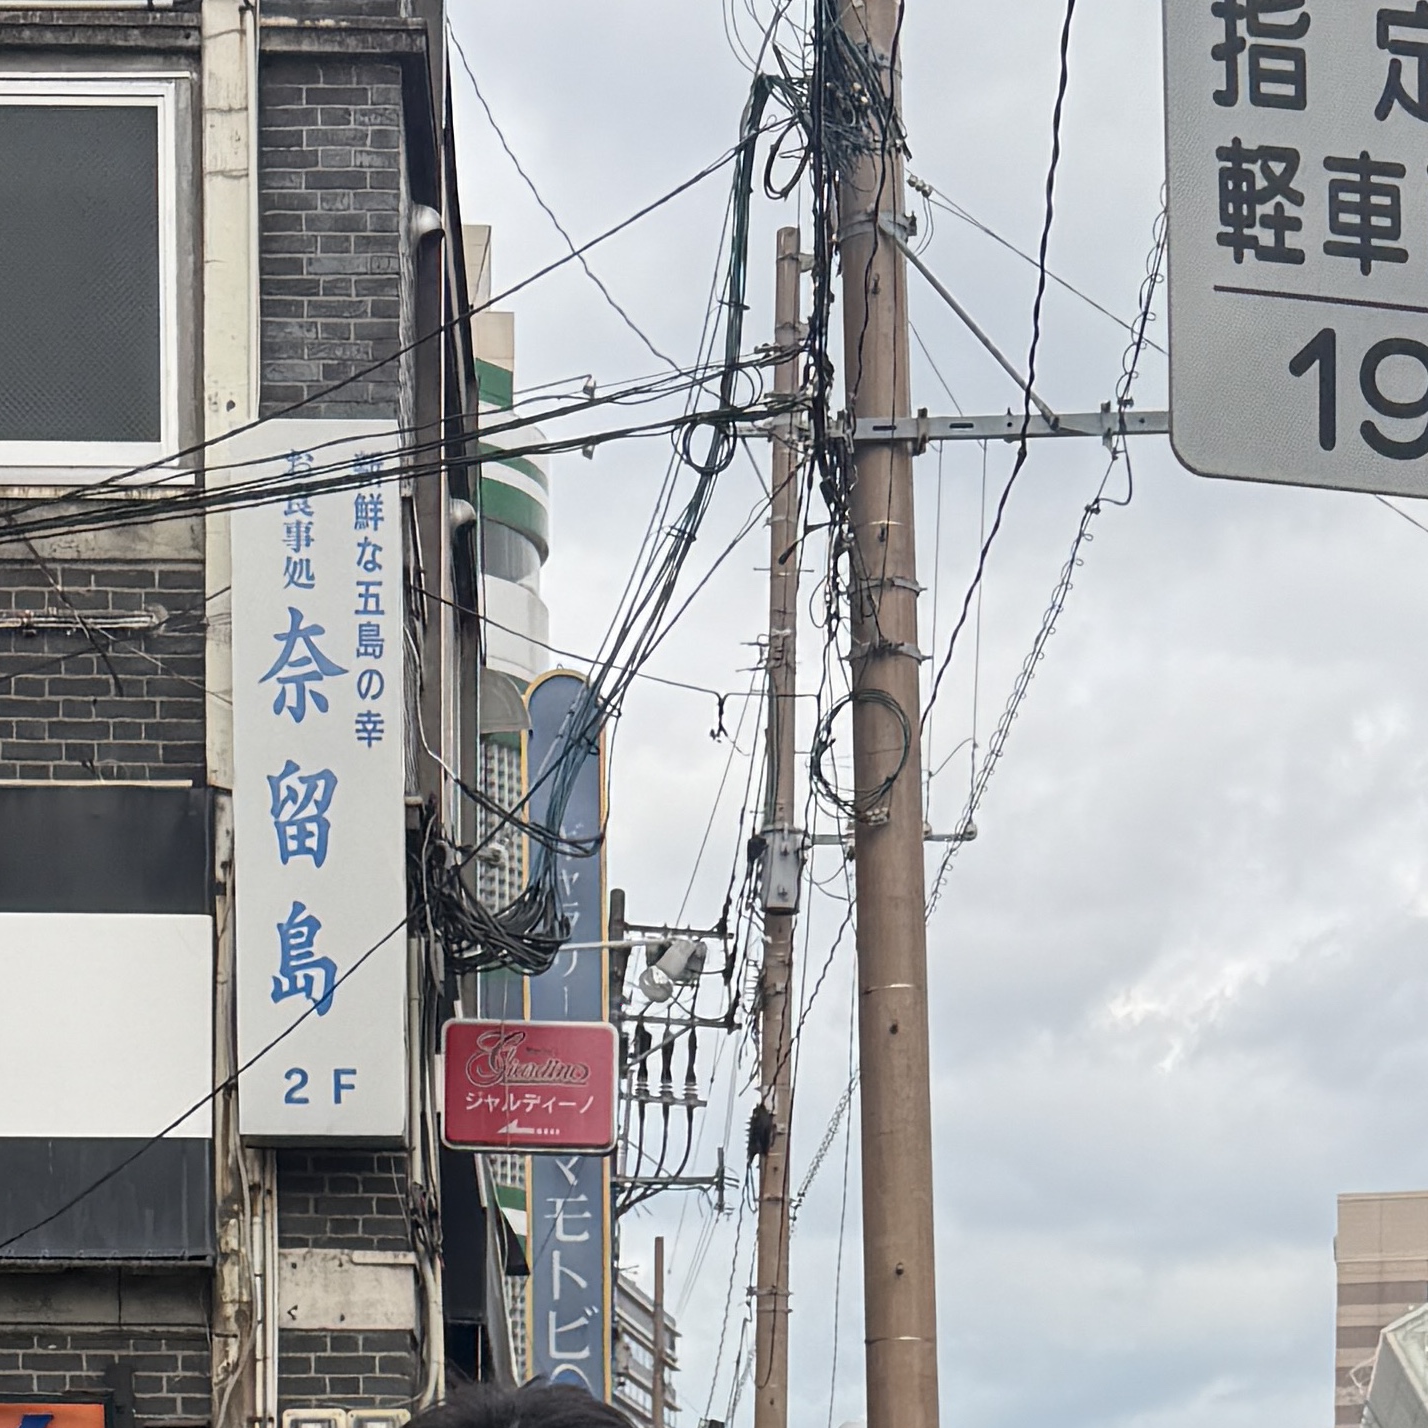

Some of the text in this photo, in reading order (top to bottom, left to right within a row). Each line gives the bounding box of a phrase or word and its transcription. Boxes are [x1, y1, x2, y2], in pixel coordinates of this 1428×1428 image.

[258, 606, 349, 1017] 奈留島
[465, 1091, 595, 1114] ジャルディーノ
